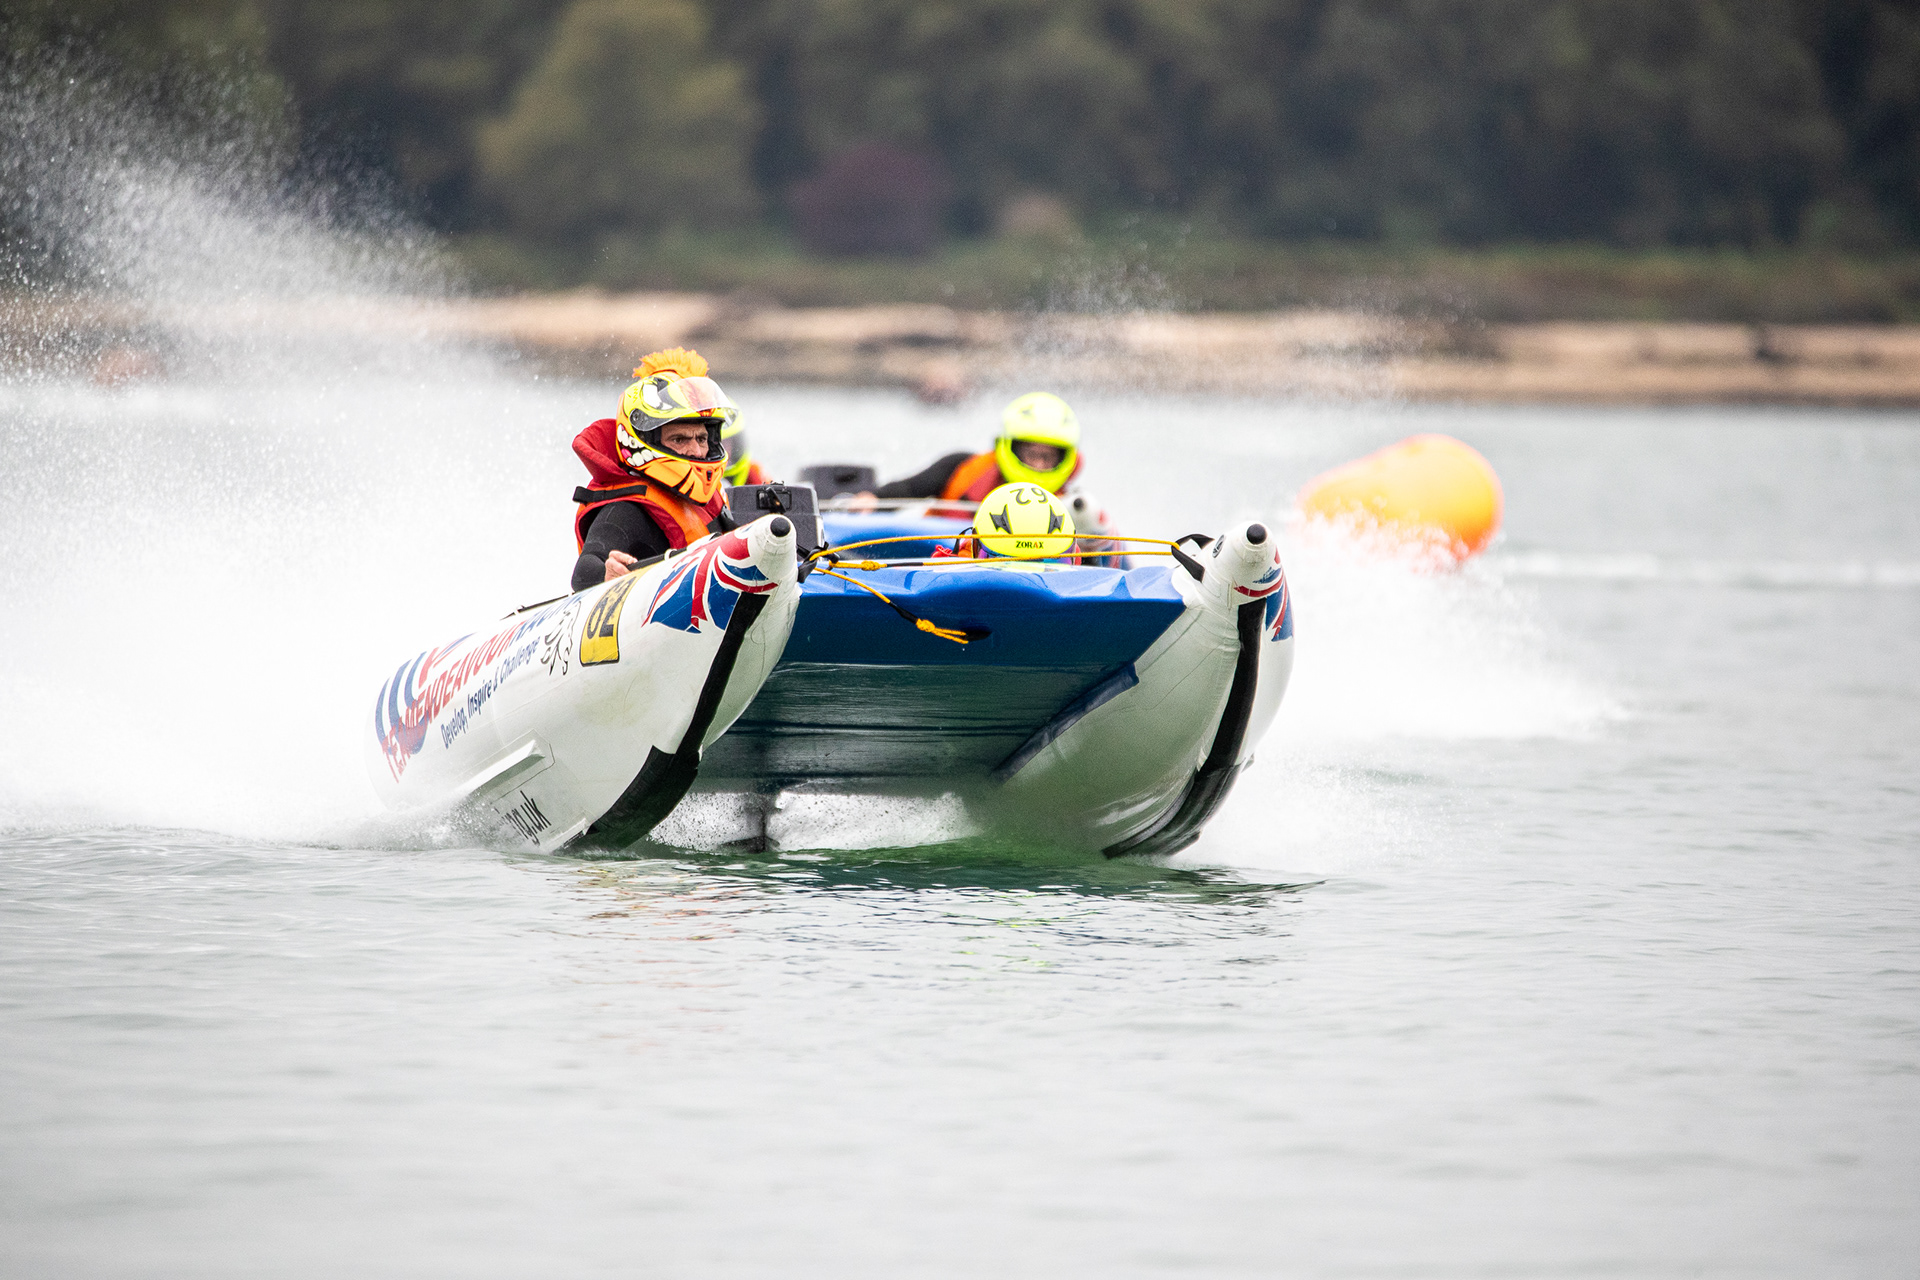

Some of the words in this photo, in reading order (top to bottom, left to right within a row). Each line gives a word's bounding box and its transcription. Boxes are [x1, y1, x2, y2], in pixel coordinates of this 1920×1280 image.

[1010, 487, 1048, 505] 62
[1015, 540, 1044, 549] ZORAX
[440, 707, 469, 750] Develop,
[467, 679, 493, 719] Inspire
[500, 635, 541, 685] Challenge
